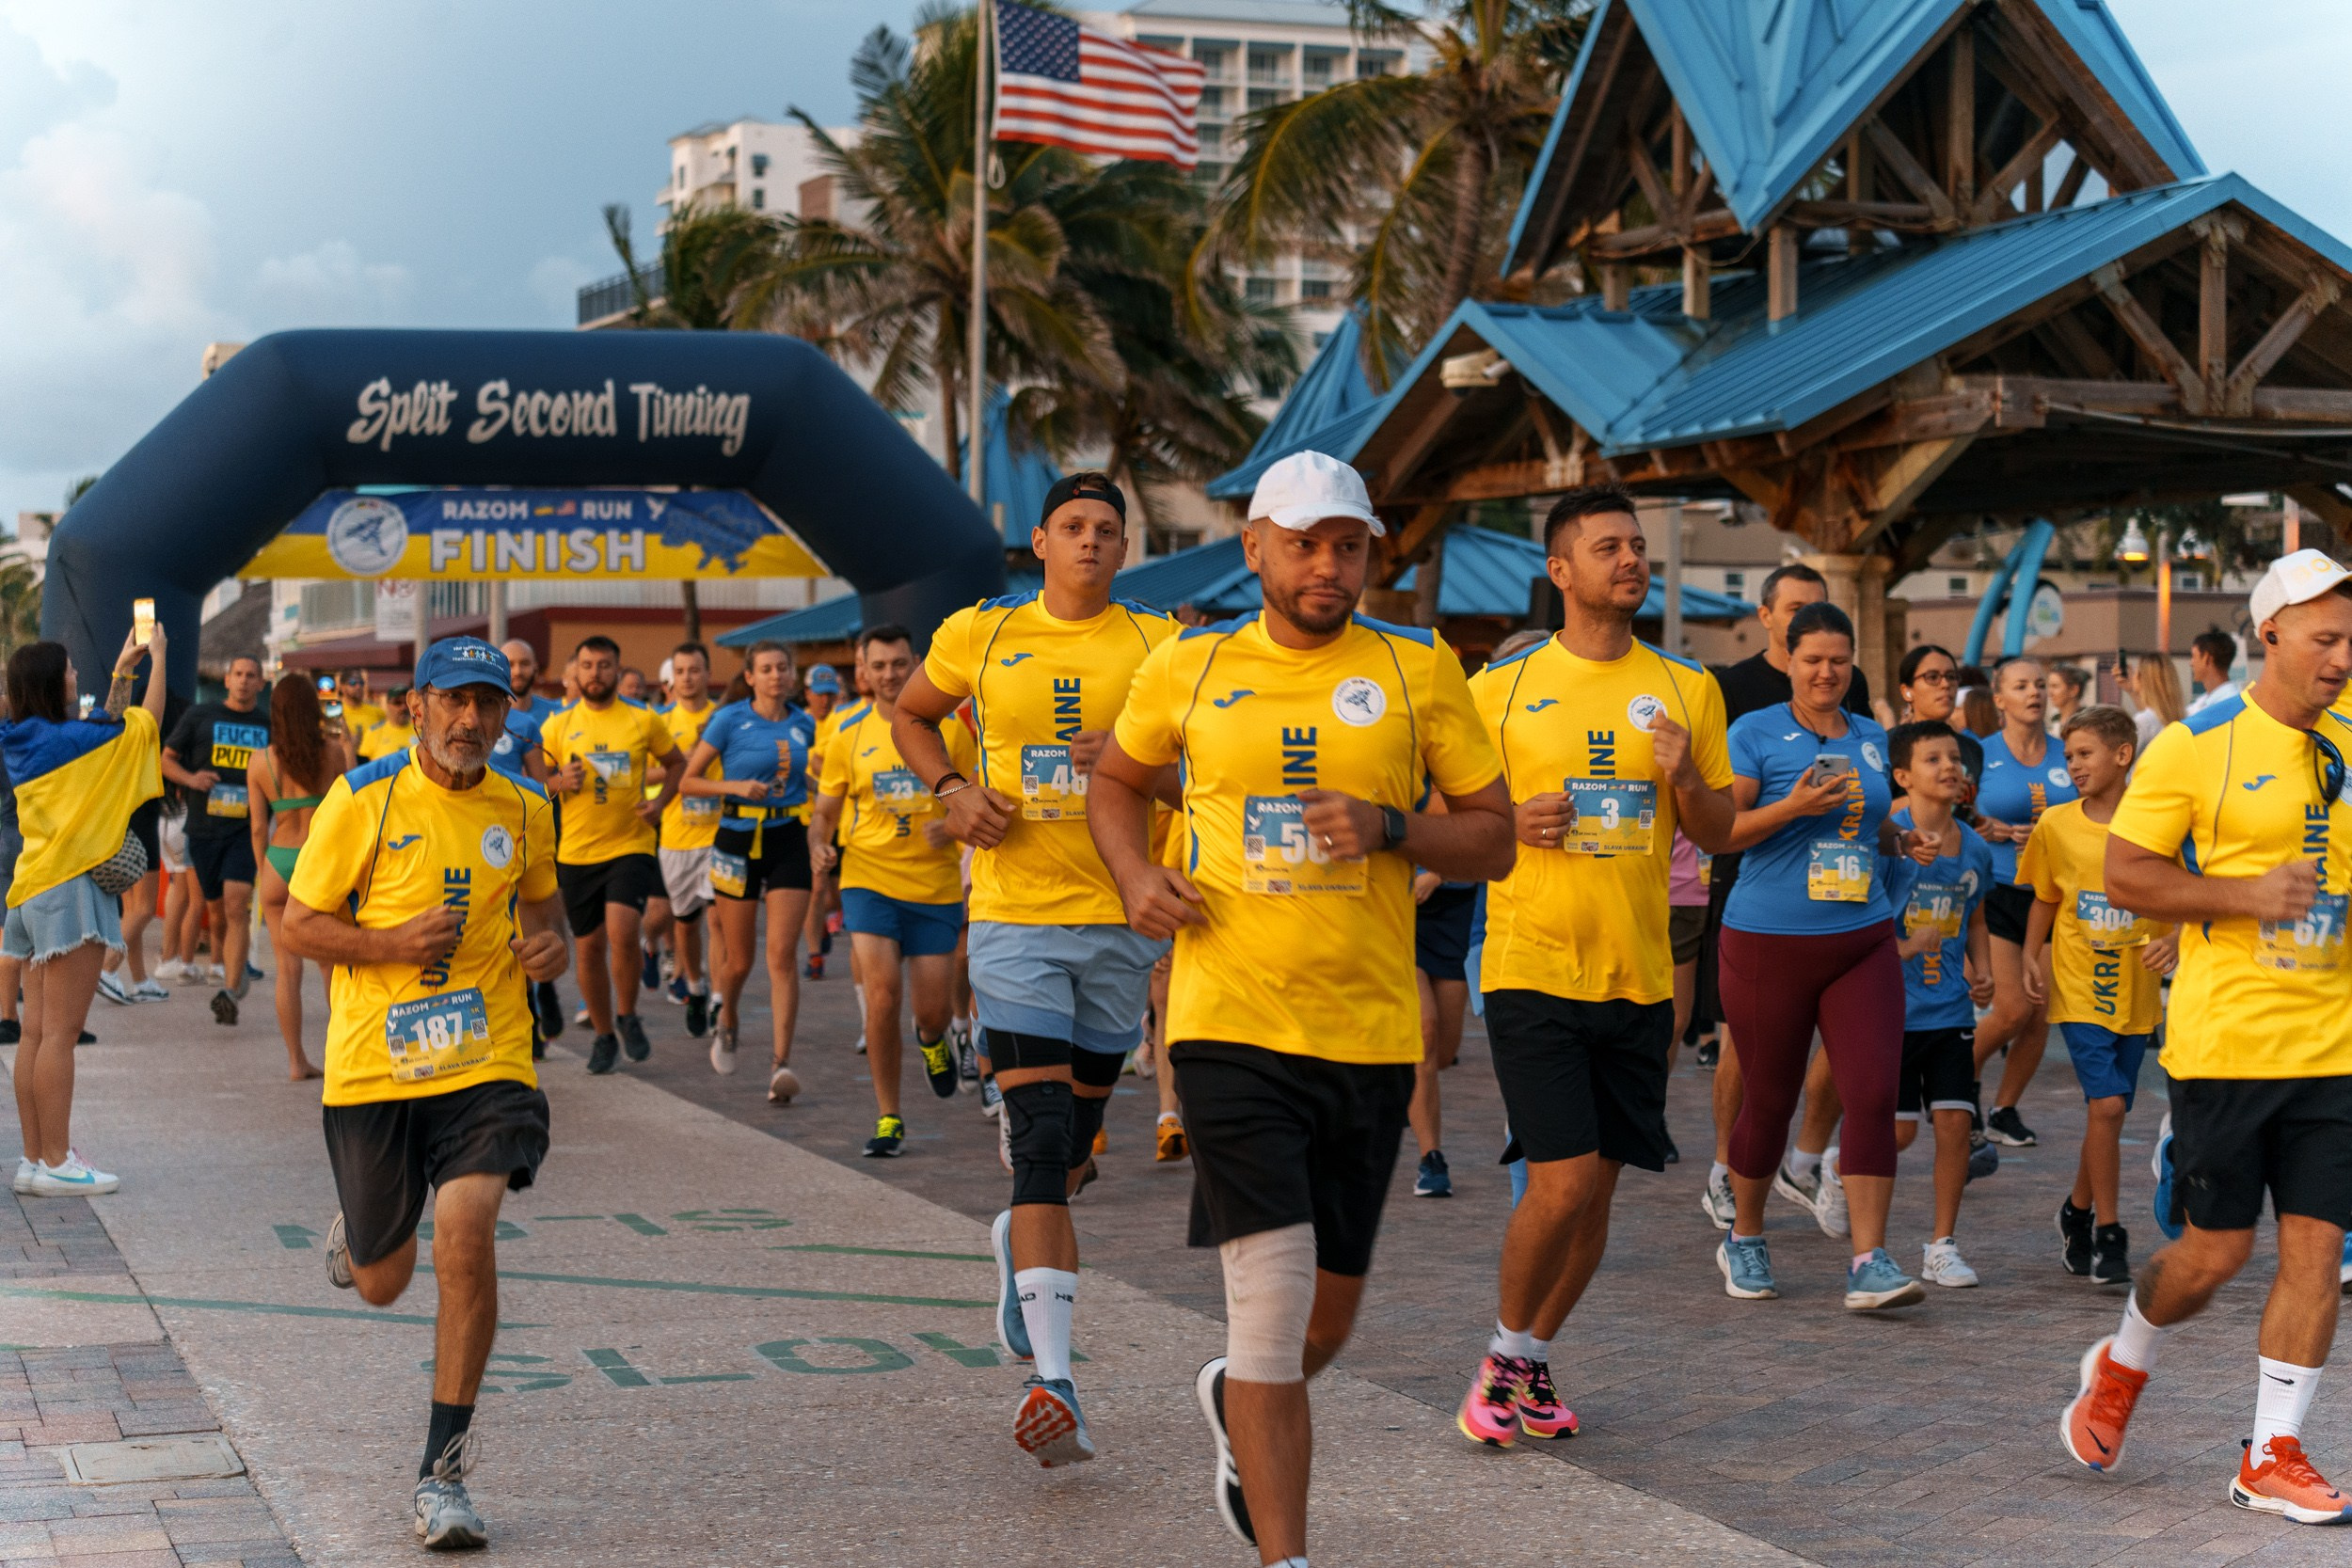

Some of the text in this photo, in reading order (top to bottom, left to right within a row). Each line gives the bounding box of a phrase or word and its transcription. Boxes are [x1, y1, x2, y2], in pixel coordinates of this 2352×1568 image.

[346, 377, 750, 457] Split Second Timing
[442, 500, 633, 520] RAZOM RUN
[430, 528, 646, 573] FINISH
[1054, 678, 1082, 745] AINE
[217, 725, 266, 747] FUCK
[1031, 750, 1067, 758] RAZOM
[890, 780, 914, 800] 23
[1050, 764, 1089, 796] 48
[1572, 782, 1647, 792] RAZOM RUN
[1256, 801, 1303, 815] RAZOM
[1600, 798, 1620, 830] 3
[1838, 768, 1866, 841] KRAINE
[1835, 854, 1861, 881] 16
[1931, 895, 1952, 921] 18
[2089, 905, 2134, 932] 304
[2293, 912, 2332, 949] 67
[391, 992, 472, 1019] RAZOM RUN
[410, 1010, 463, 1053] 187
